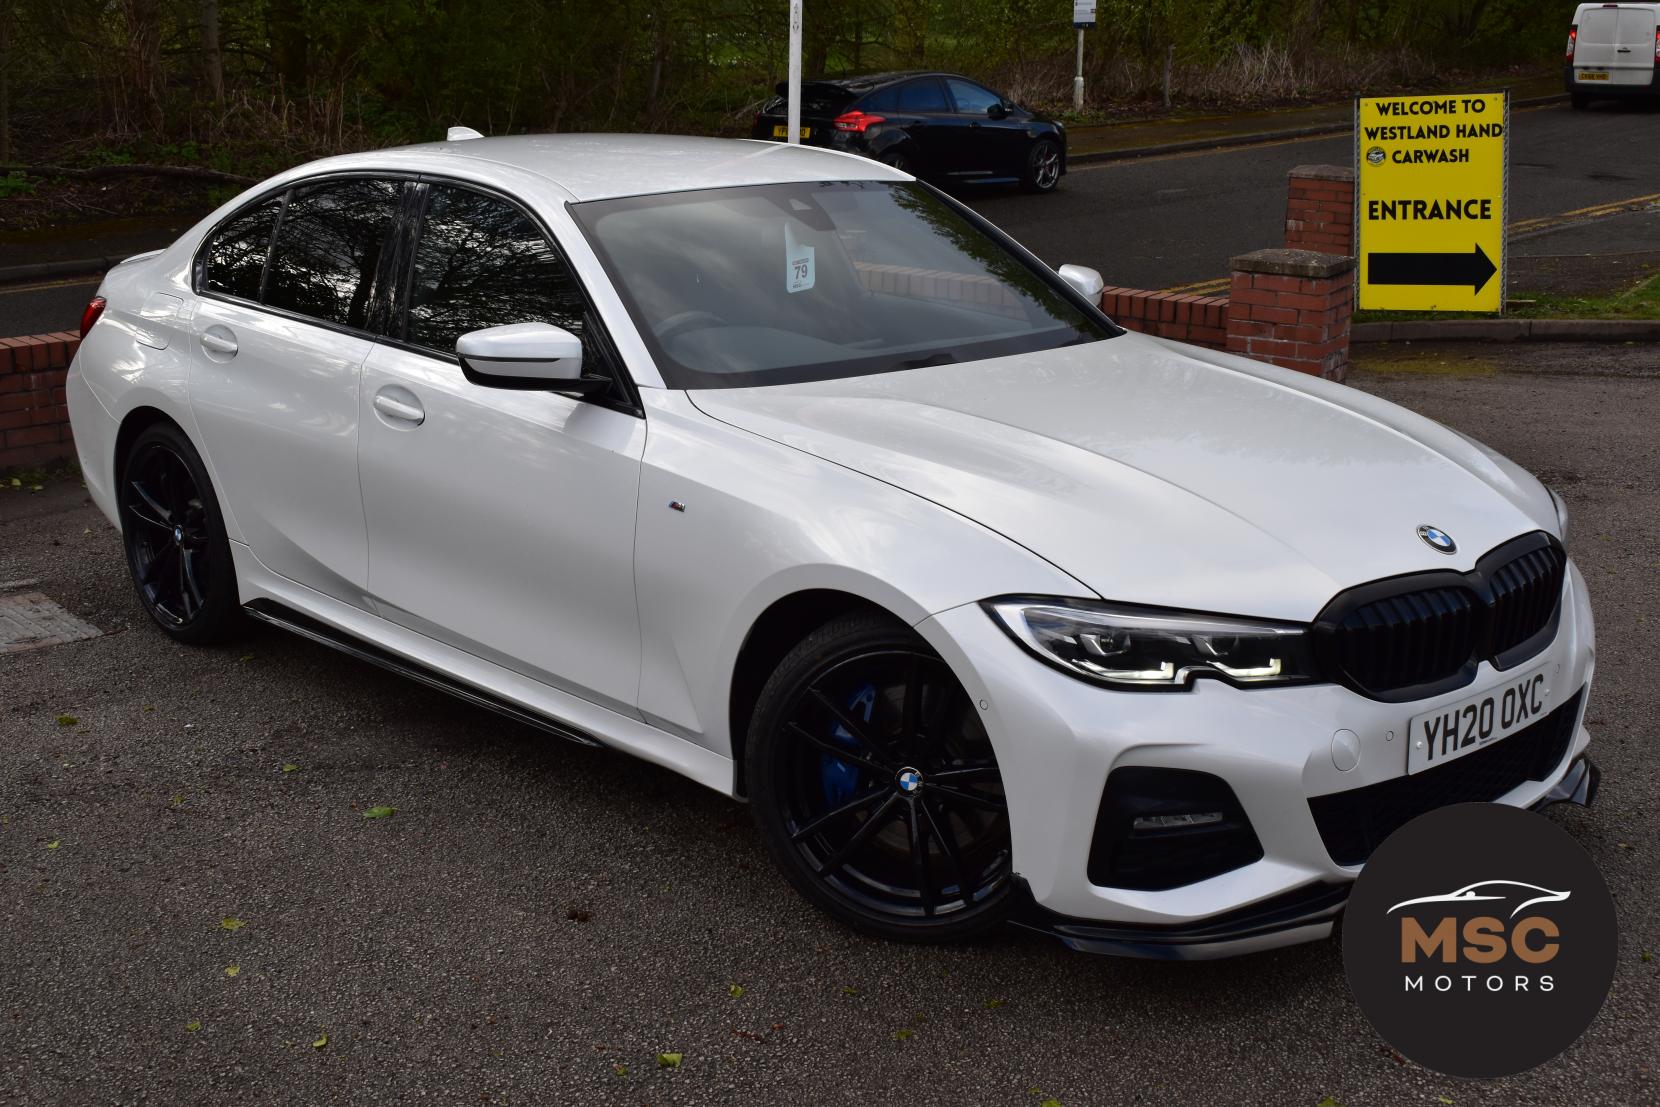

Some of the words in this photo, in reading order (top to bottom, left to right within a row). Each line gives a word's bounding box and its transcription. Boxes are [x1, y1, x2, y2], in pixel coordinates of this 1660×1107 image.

[1376, 100, 1456, 116] WELCOME
[1462, 99, 1485, 113] TO
[1365, 125, 1450, 140] WESTLAND
[1456, 123, 1503, 138] HAND
[1392, 149, 1469, 163] CARWASH
[1368, 199, 1491, 220] ENTRANCE
[794, 264, 808, 280] 79
[1424, 697, 1495, 761] YH20
[1501, 673, 1544, 730] OXC
